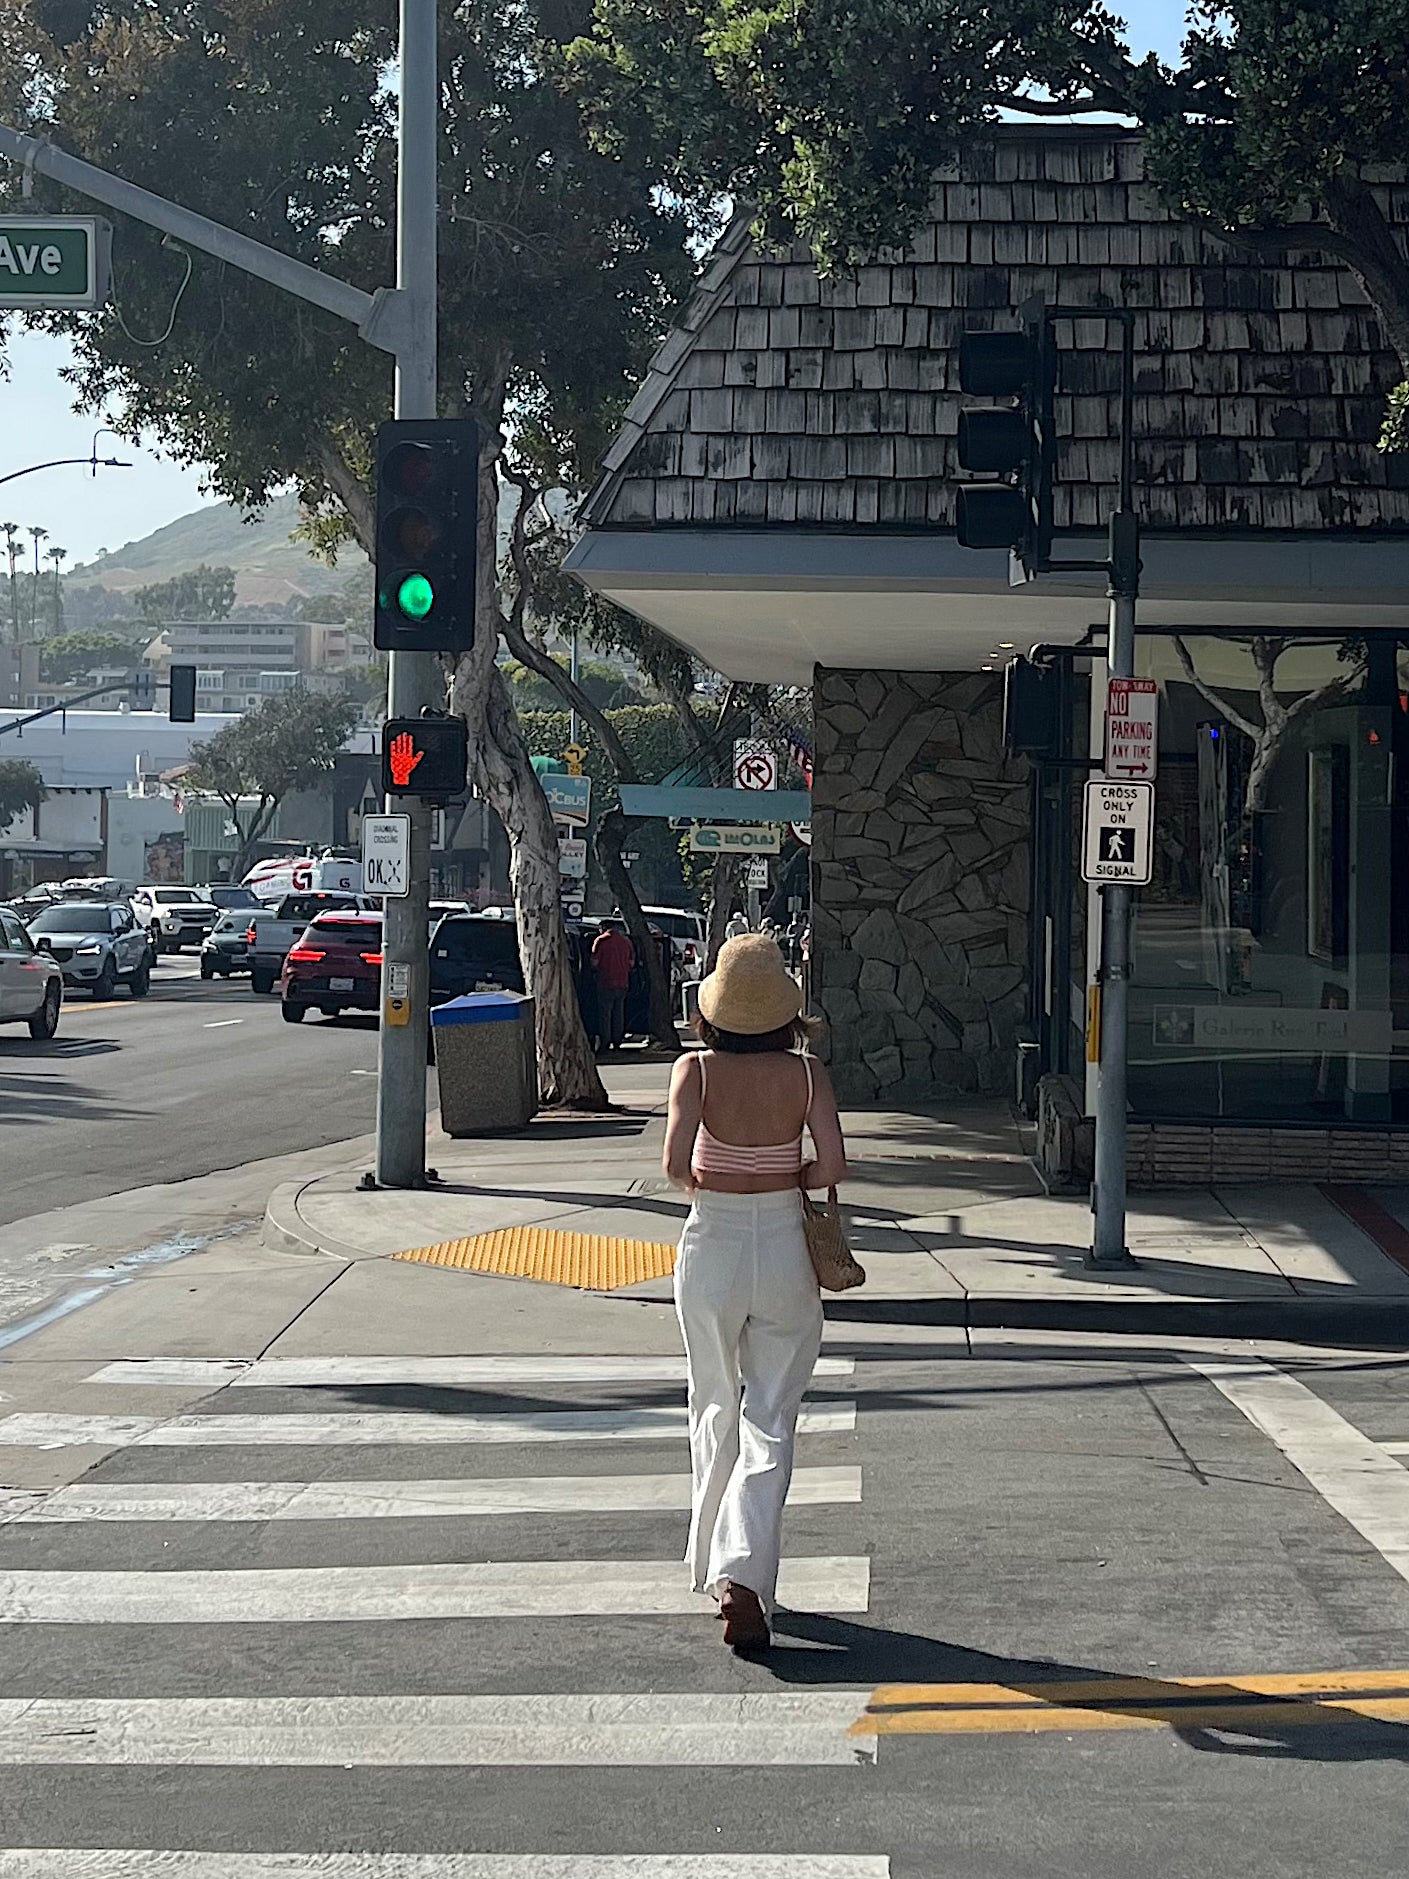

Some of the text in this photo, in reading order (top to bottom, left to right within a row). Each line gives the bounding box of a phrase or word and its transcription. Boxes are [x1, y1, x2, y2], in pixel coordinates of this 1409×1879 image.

[0, 235, 62, 275] Ave
[1110, 692, 1127, 714] NO
[1112, 721, 1153, 740] PARKING
[1112, 744, 1152, 759] ANY TIME
[1101, 787, 1138, 799] CROSS
[1103, 800, 1135, 811] ONLY
[1110, 813, 1126, 824] ON
[1096, 864, 1137, 876] SIGNAL
